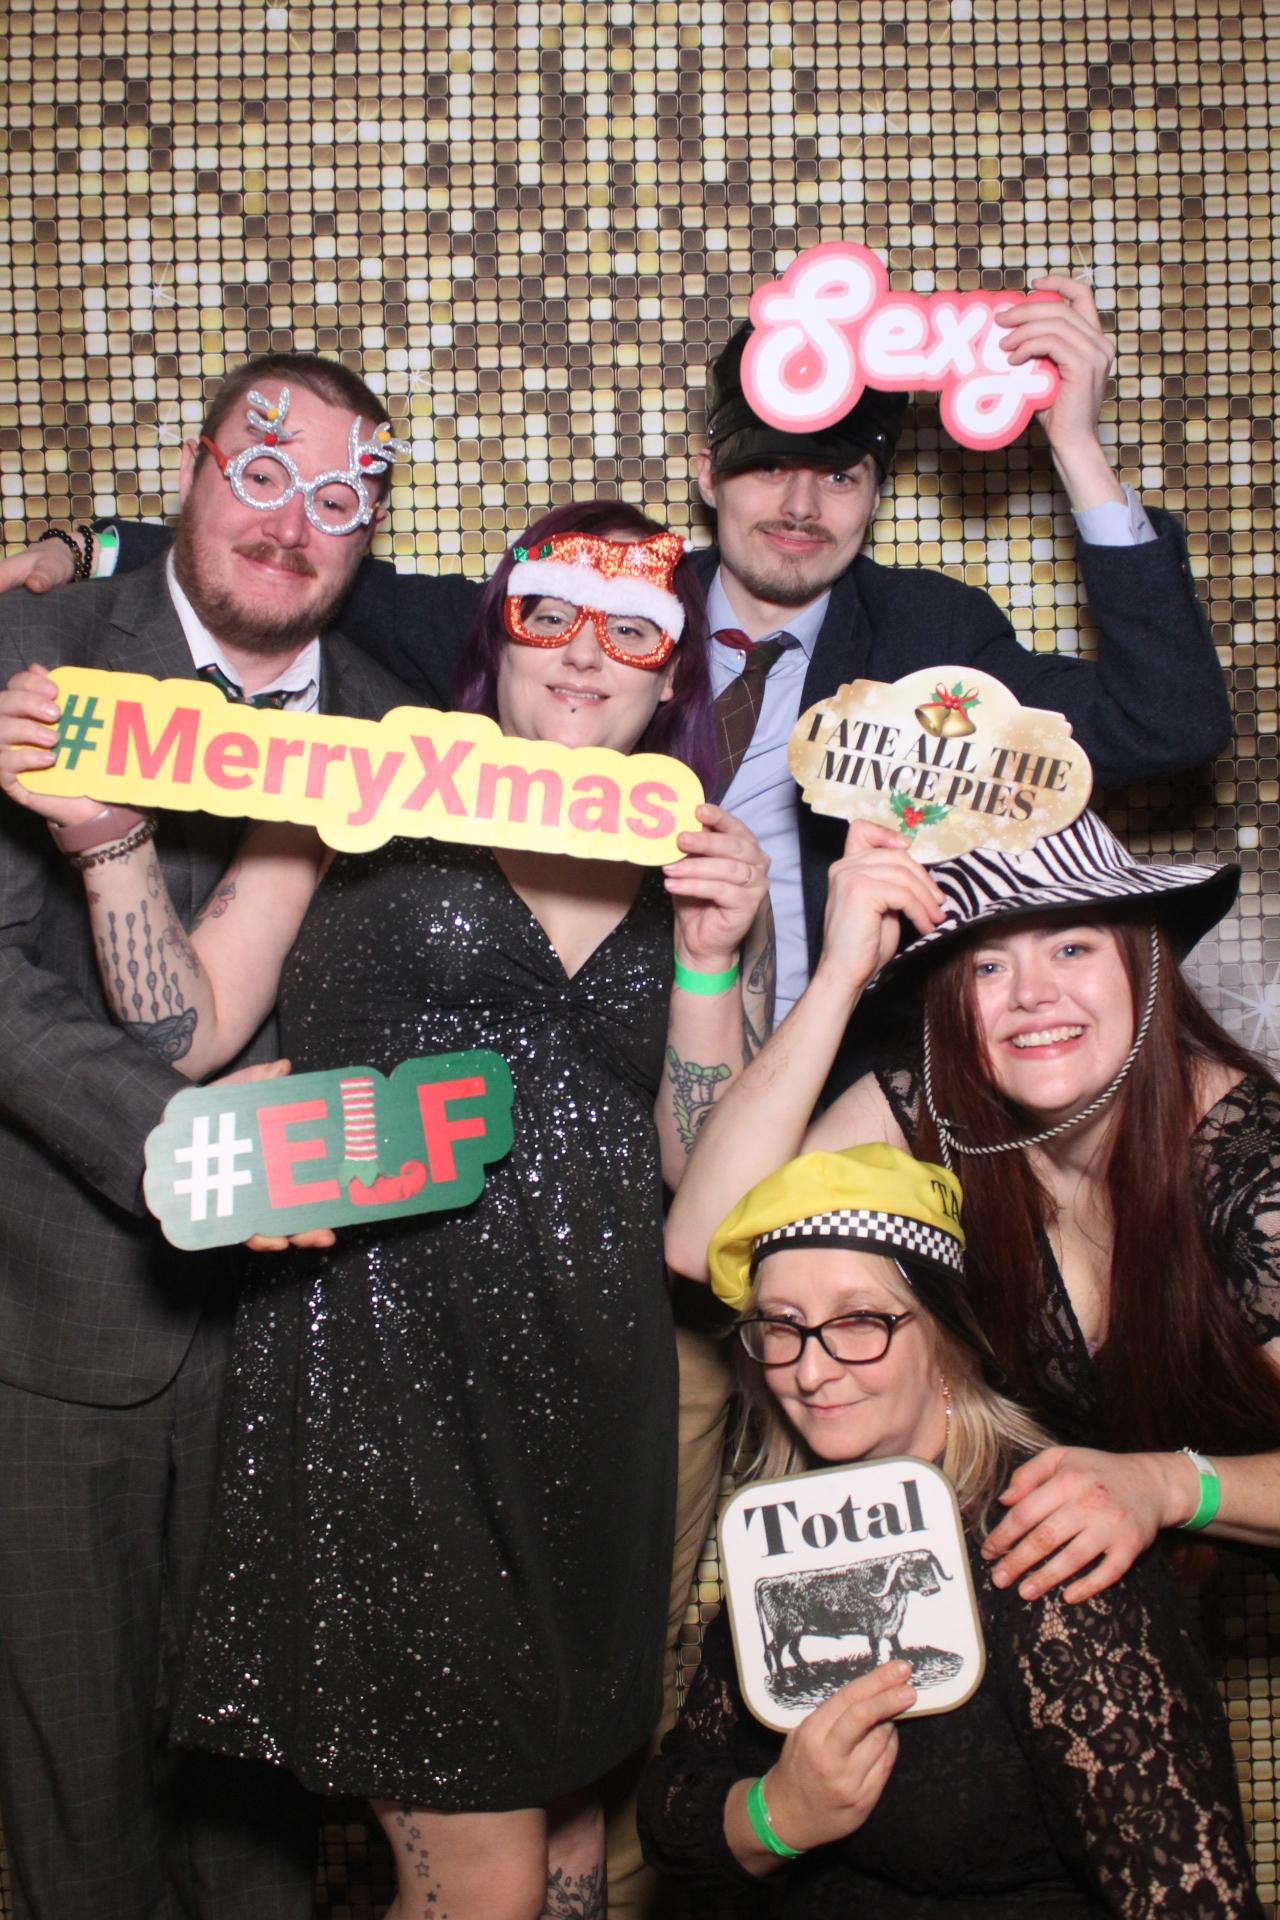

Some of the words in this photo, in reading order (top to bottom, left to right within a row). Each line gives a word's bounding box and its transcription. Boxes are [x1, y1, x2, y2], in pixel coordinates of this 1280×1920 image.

[755, 257, 1050, 435] Sexy
[55, 693, 679, 839] #MerryXmas
[804, 712, 824, 743] I
[825, 717, 902, 758] ATE
[903, 733, 978, 774] ALL
[989, 746, 1073, 792] THE
[816, 750, 941, 802] MINCE
[946, 775, 1037, 822] PIES
[743, 1479, 930, 1558] Total
